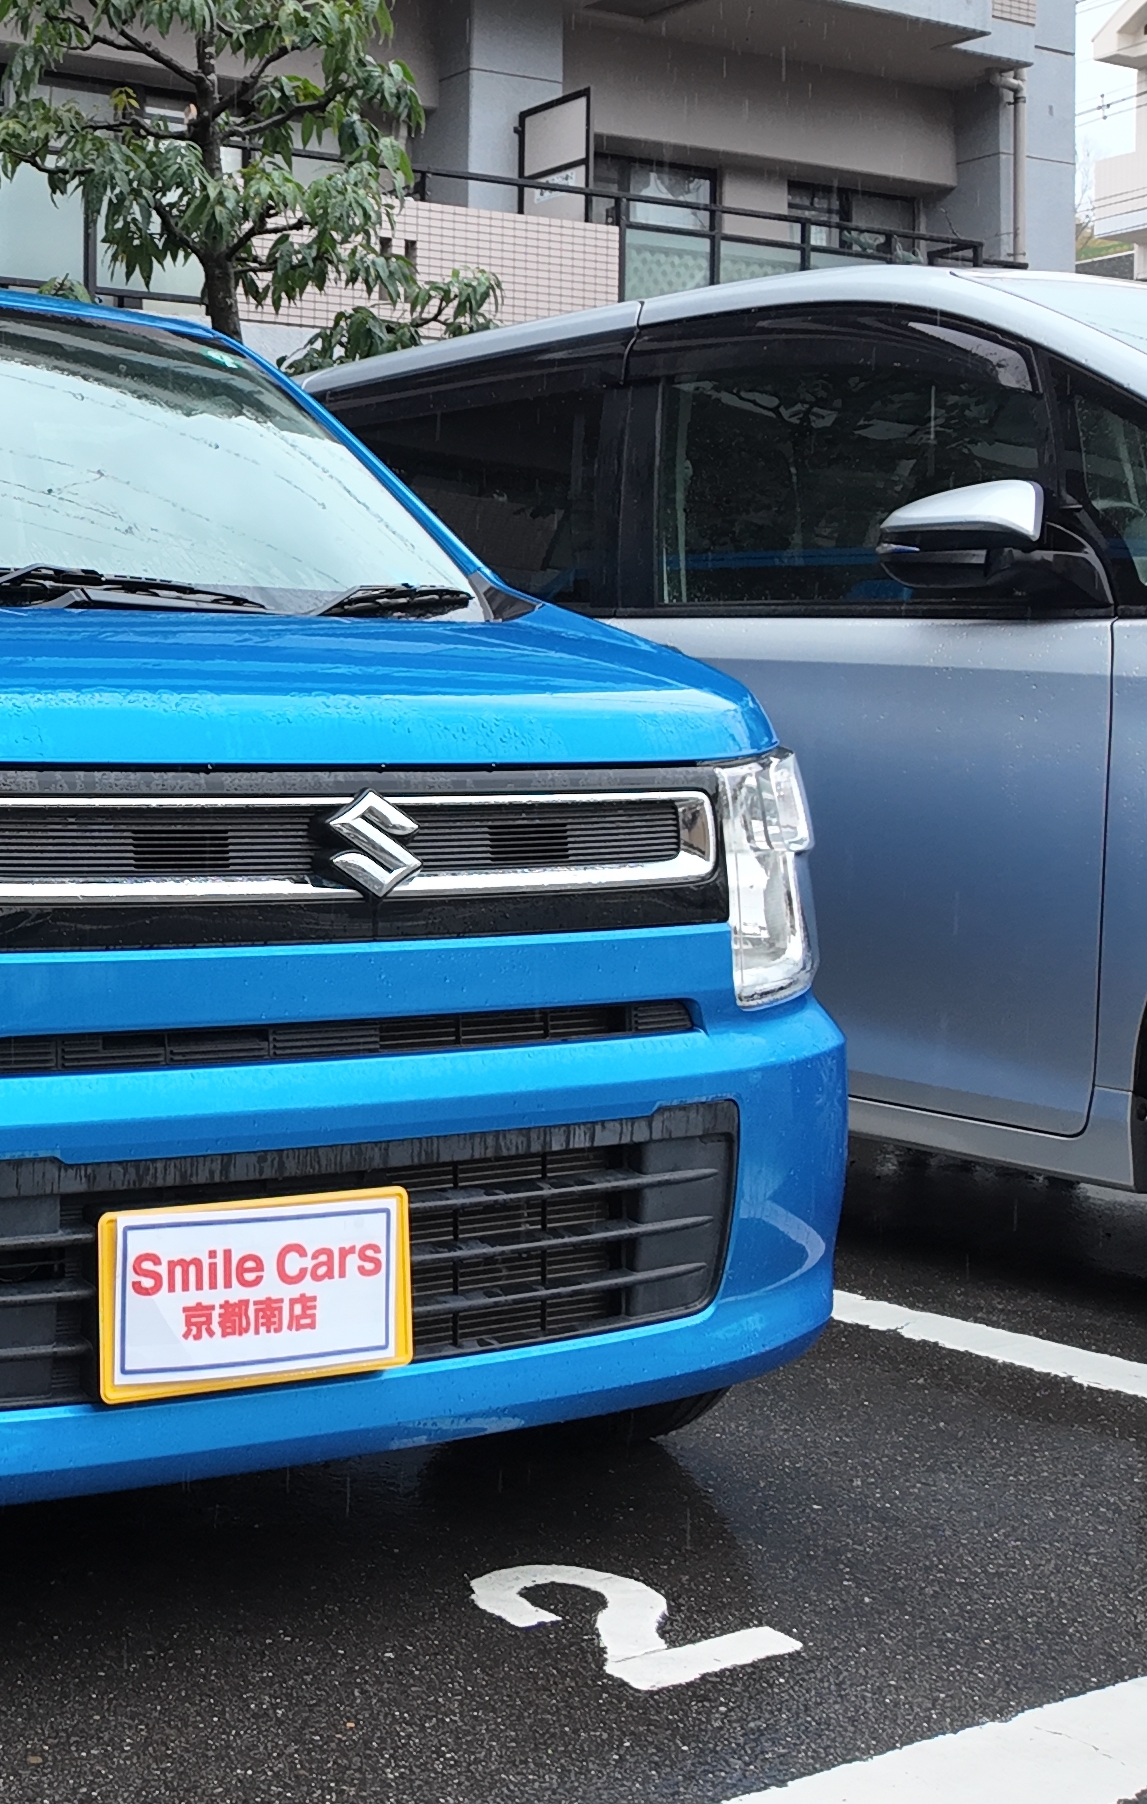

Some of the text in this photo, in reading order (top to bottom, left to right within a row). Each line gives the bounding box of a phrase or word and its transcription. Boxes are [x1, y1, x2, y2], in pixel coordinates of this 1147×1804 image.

[130, 1242, 383, 1297] Smile Cars
[181, 1292, 318, 1341] 京都南店
[470, 1564, 804, 1691] 2
